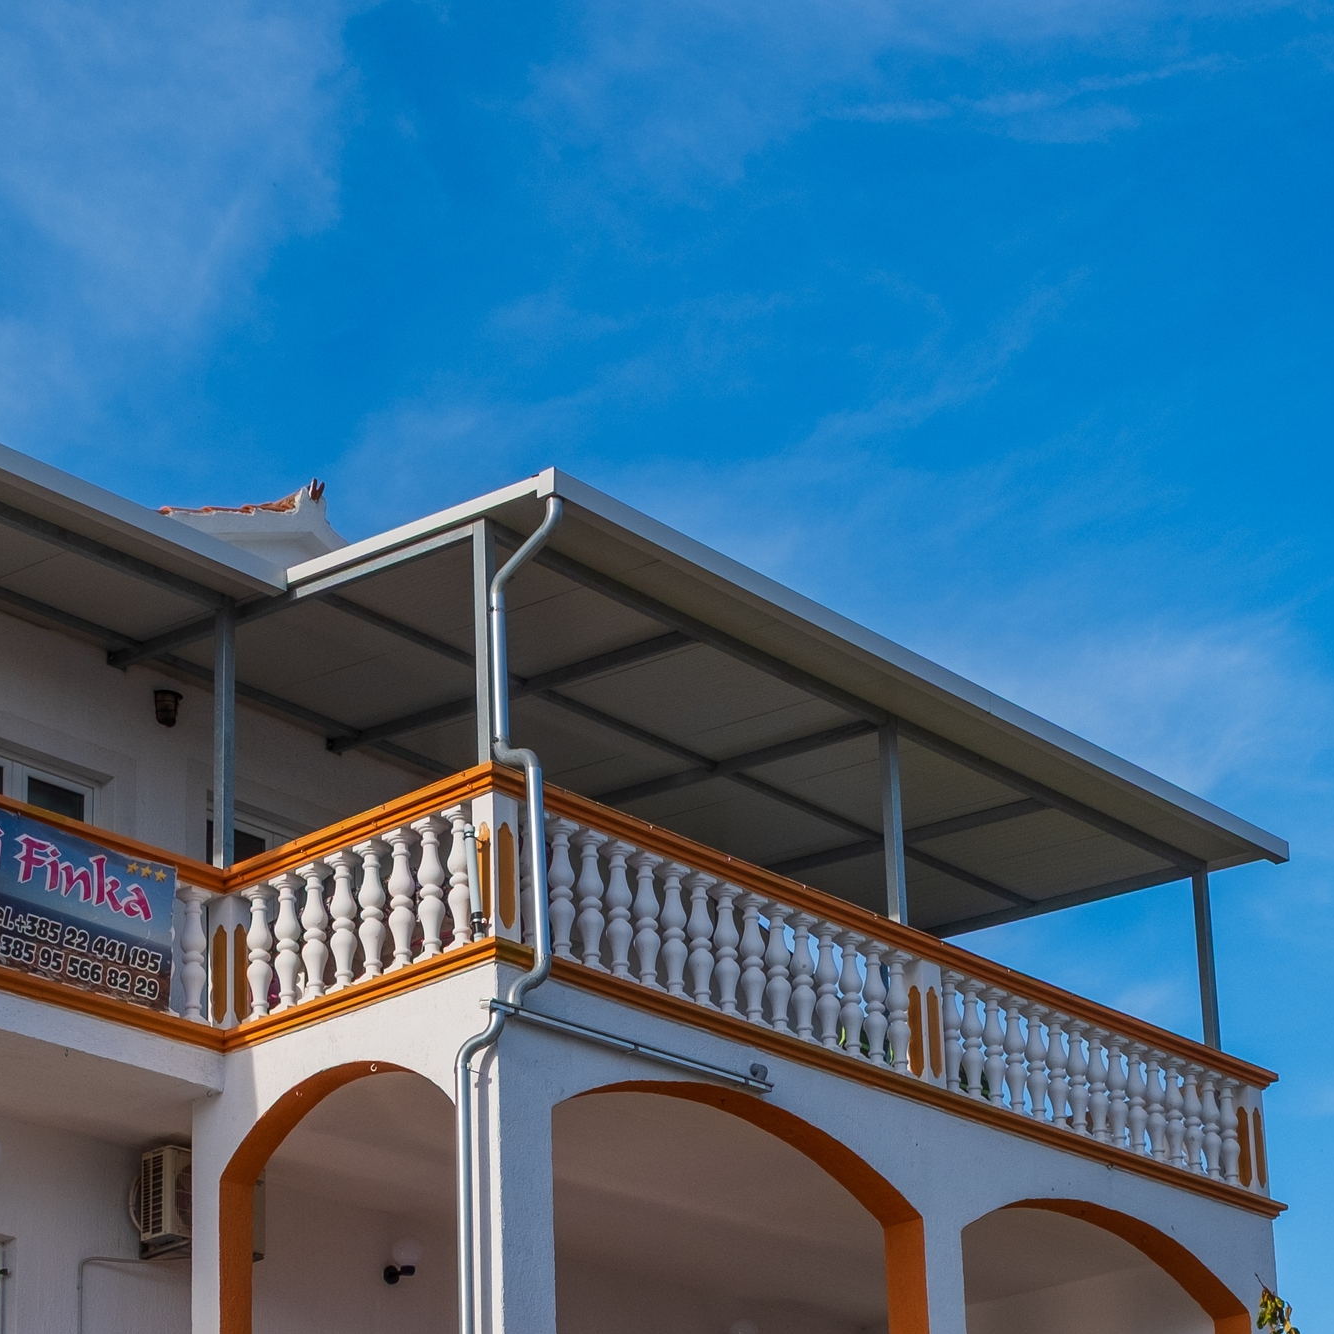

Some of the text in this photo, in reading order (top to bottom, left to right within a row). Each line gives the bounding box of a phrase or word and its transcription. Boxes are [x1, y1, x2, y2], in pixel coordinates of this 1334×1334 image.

[14, 833, 154, 922] Finka
[38, 947, 65, 973] 95
[66, 956, 104, 984] 566
[106, 967, 132, 993] 82
[134, 975, 160, 1000] 29
[63, 926, 90, 953] 22
[92, 936, 127, 963] 441
[129, 946, 163, 975] 195
